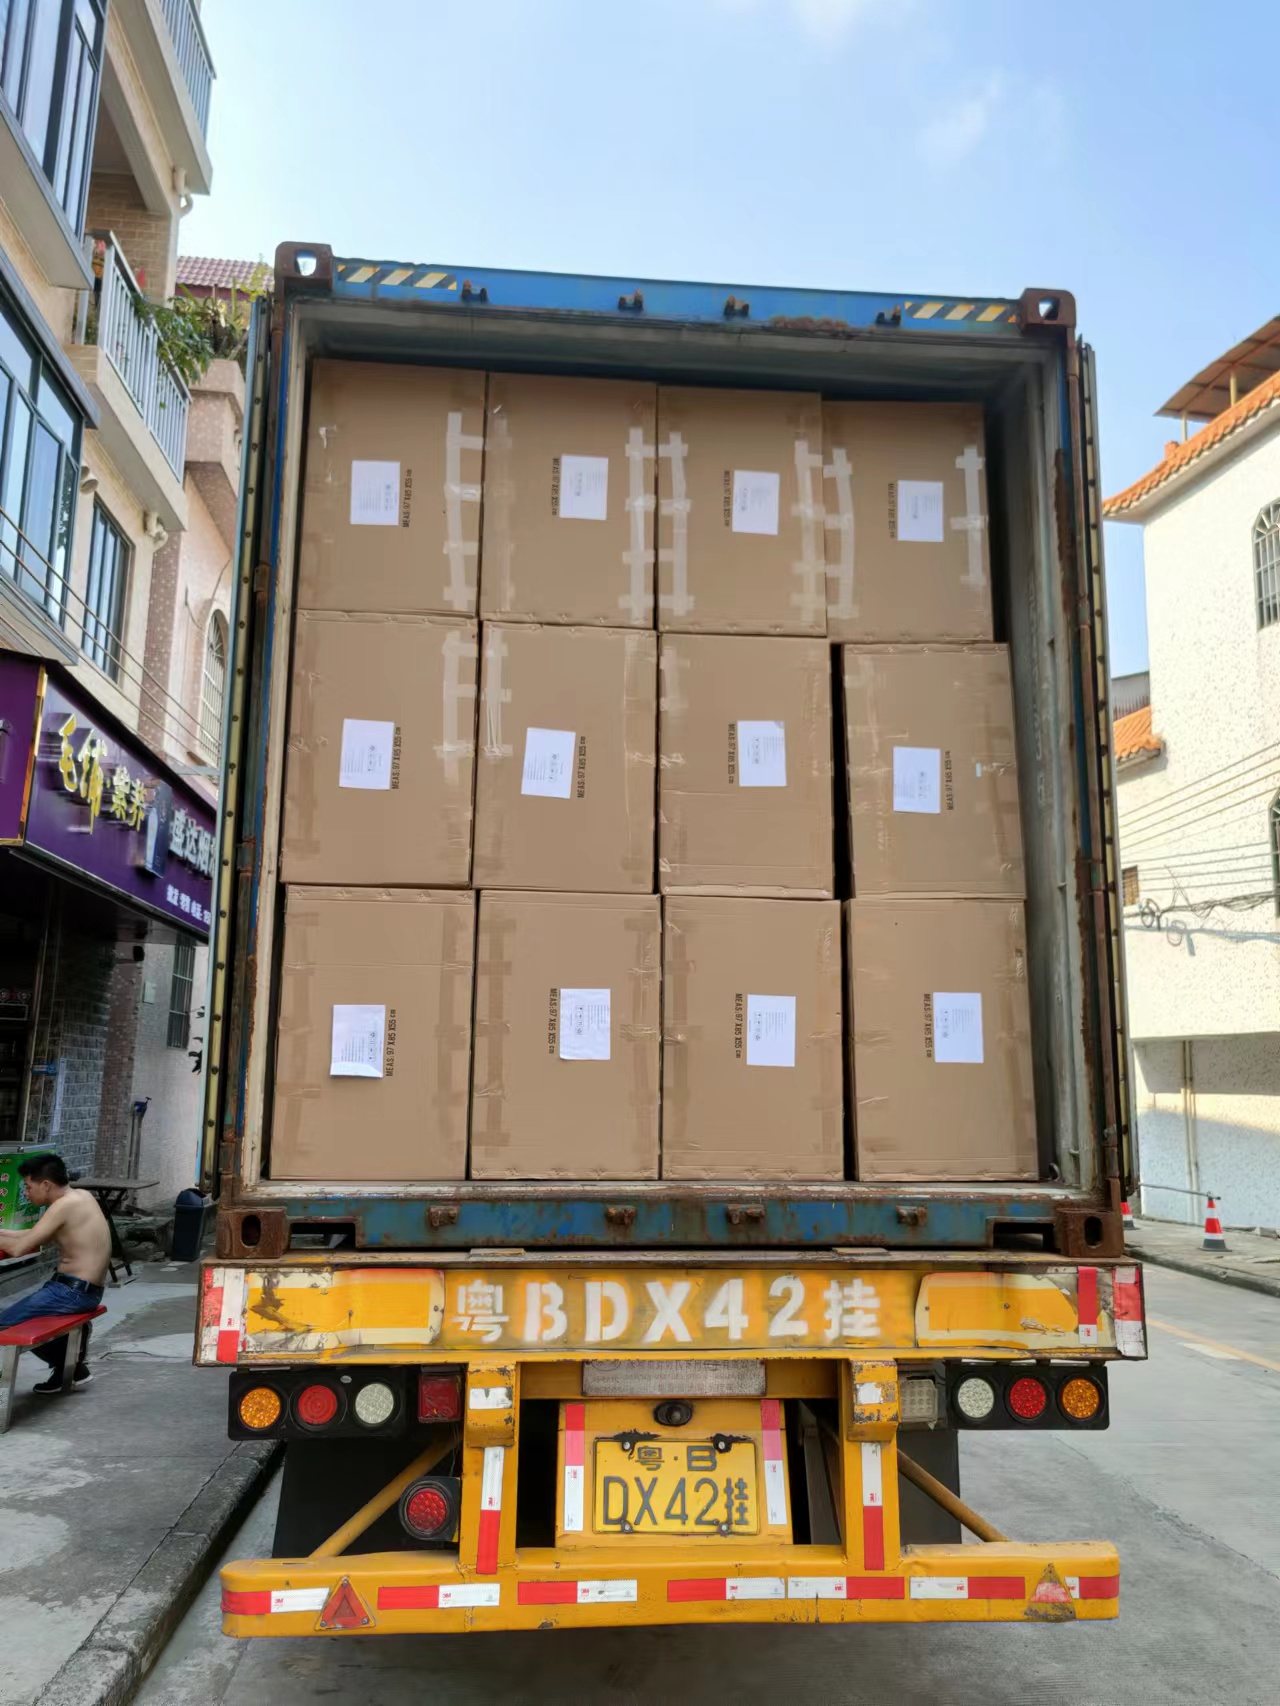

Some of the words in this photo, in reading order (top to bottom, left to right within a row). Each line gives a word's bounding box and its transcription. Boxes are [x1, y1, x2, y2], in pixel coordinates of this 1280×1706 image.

[388, 1019, 397, 1031] X55
[548, 1018, 557, 1031] X85
[387, 1032, 396, 1045] X85
[456, 1275, 881, 1343] 粤BDX42挂
[603, 1475, 749, 1526] DX42挂
